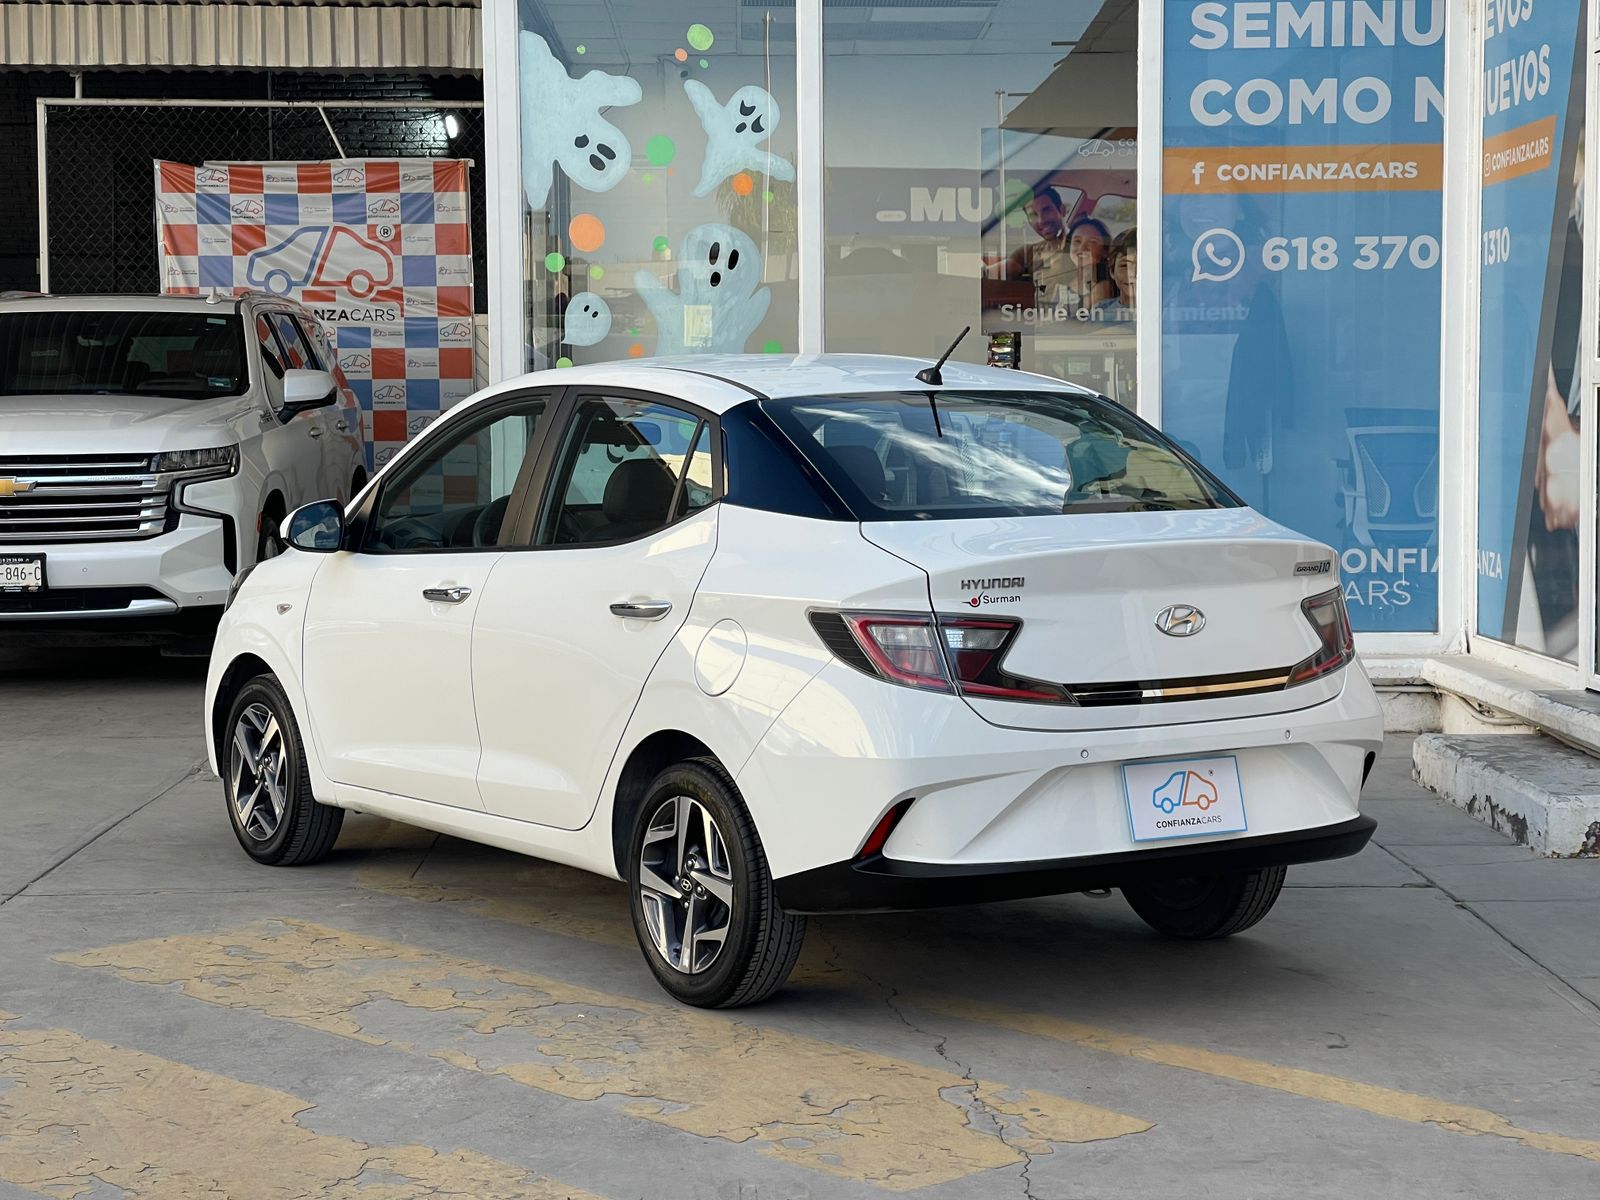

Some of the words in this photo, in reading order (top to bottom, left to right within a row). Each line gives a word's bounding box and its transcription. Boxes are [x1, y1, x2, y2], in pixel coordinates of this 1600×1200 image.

[1189, 0, 1444, 49] SEMINU
[1190, 76, 1392, 127] COMO
[1491, 136, 1549, 171] CONFIANZACARS
[1217, 161, 1418, 182] CONFIANZACARS
[1262, 236, 1339, 272] 618
[1352, 234, 1440, 271] 370
[1483, 226, 1510, 266] 1310
[1076, 306, 1105, 321] en
[1296, 565, 1319, 573] GRAND
[1341, 547, 1439, 574] ONFI
[960, 576, 1025, 590] HYUNDAI
[1344, 580, 1412, 606] ARS
[982, 595, 1021, 605] Surman
[1156, 815, 1223, 829] CONFIANZACARS
